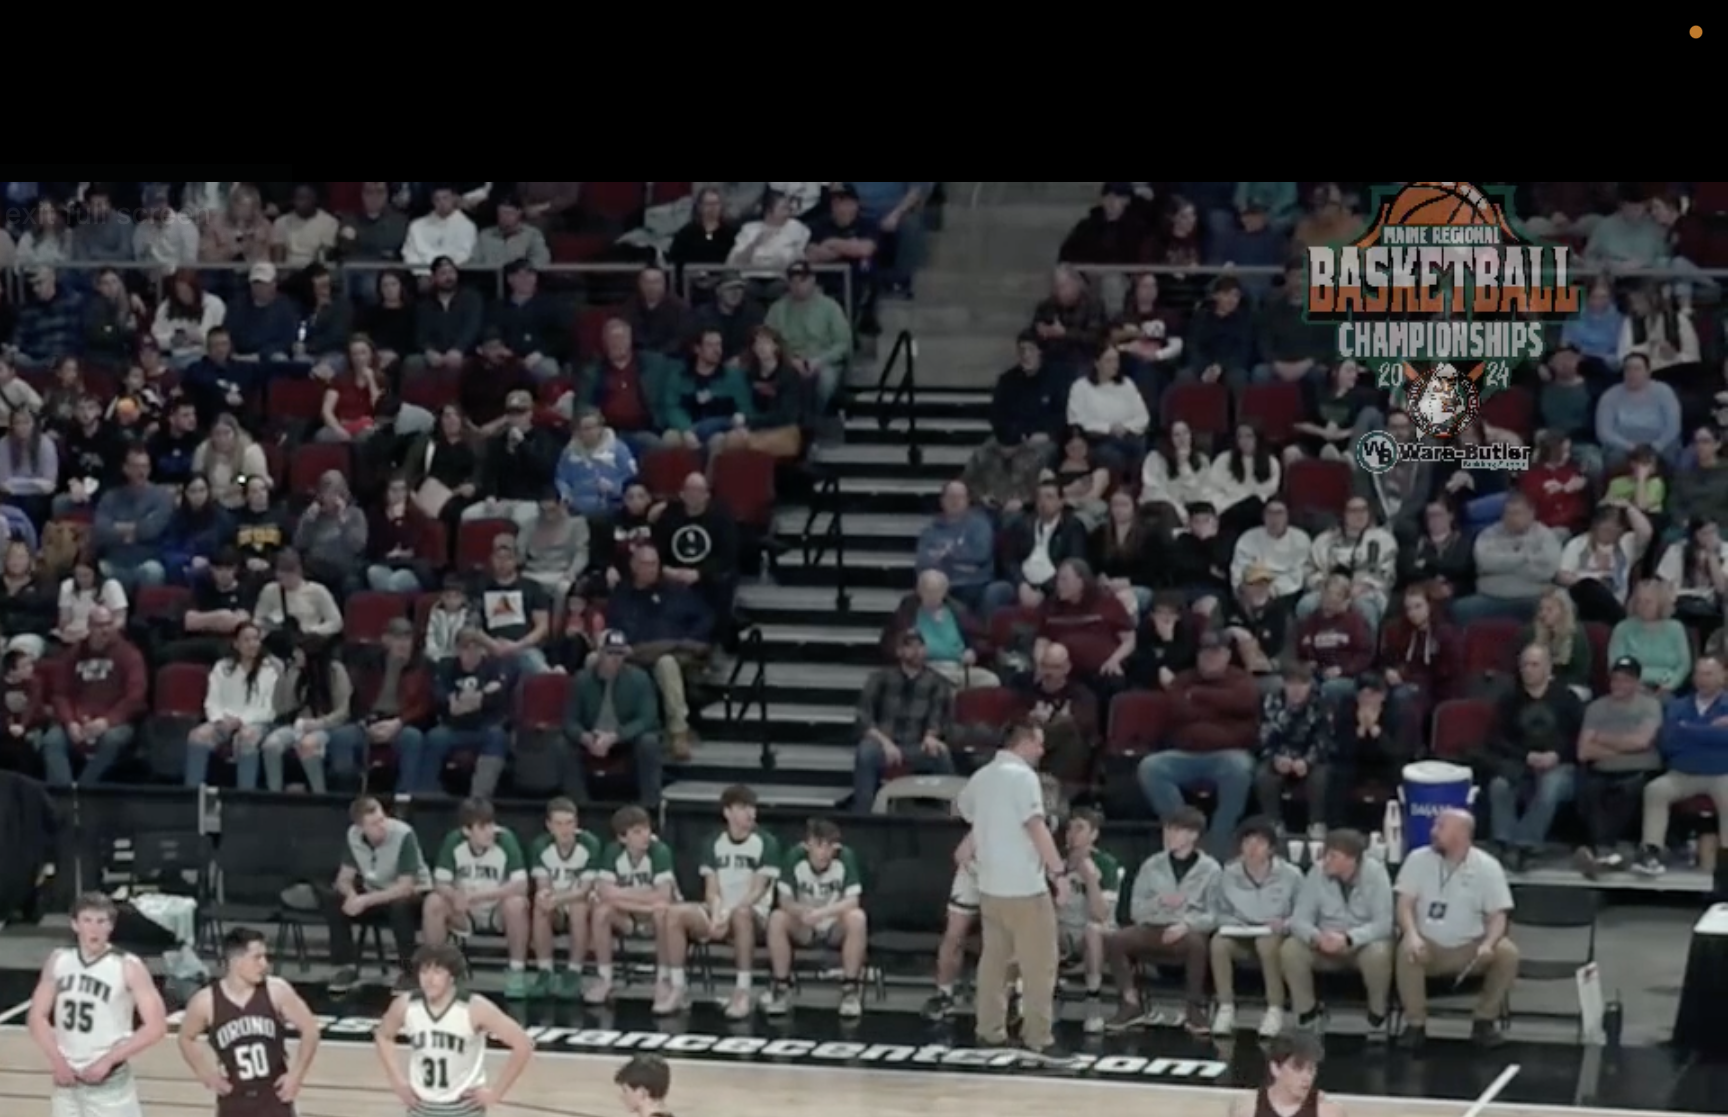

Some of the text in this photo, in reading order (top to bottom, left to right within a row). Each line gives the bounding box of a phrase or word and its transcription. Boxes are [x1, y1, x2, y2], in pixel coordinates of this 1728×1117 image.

[63, 1000, 95, 1034] 35
[217, 1015, 276, 1049] ORONO
[235, 1043, 269, 1080] 50
[423, 1057, 449, 1089] 31
